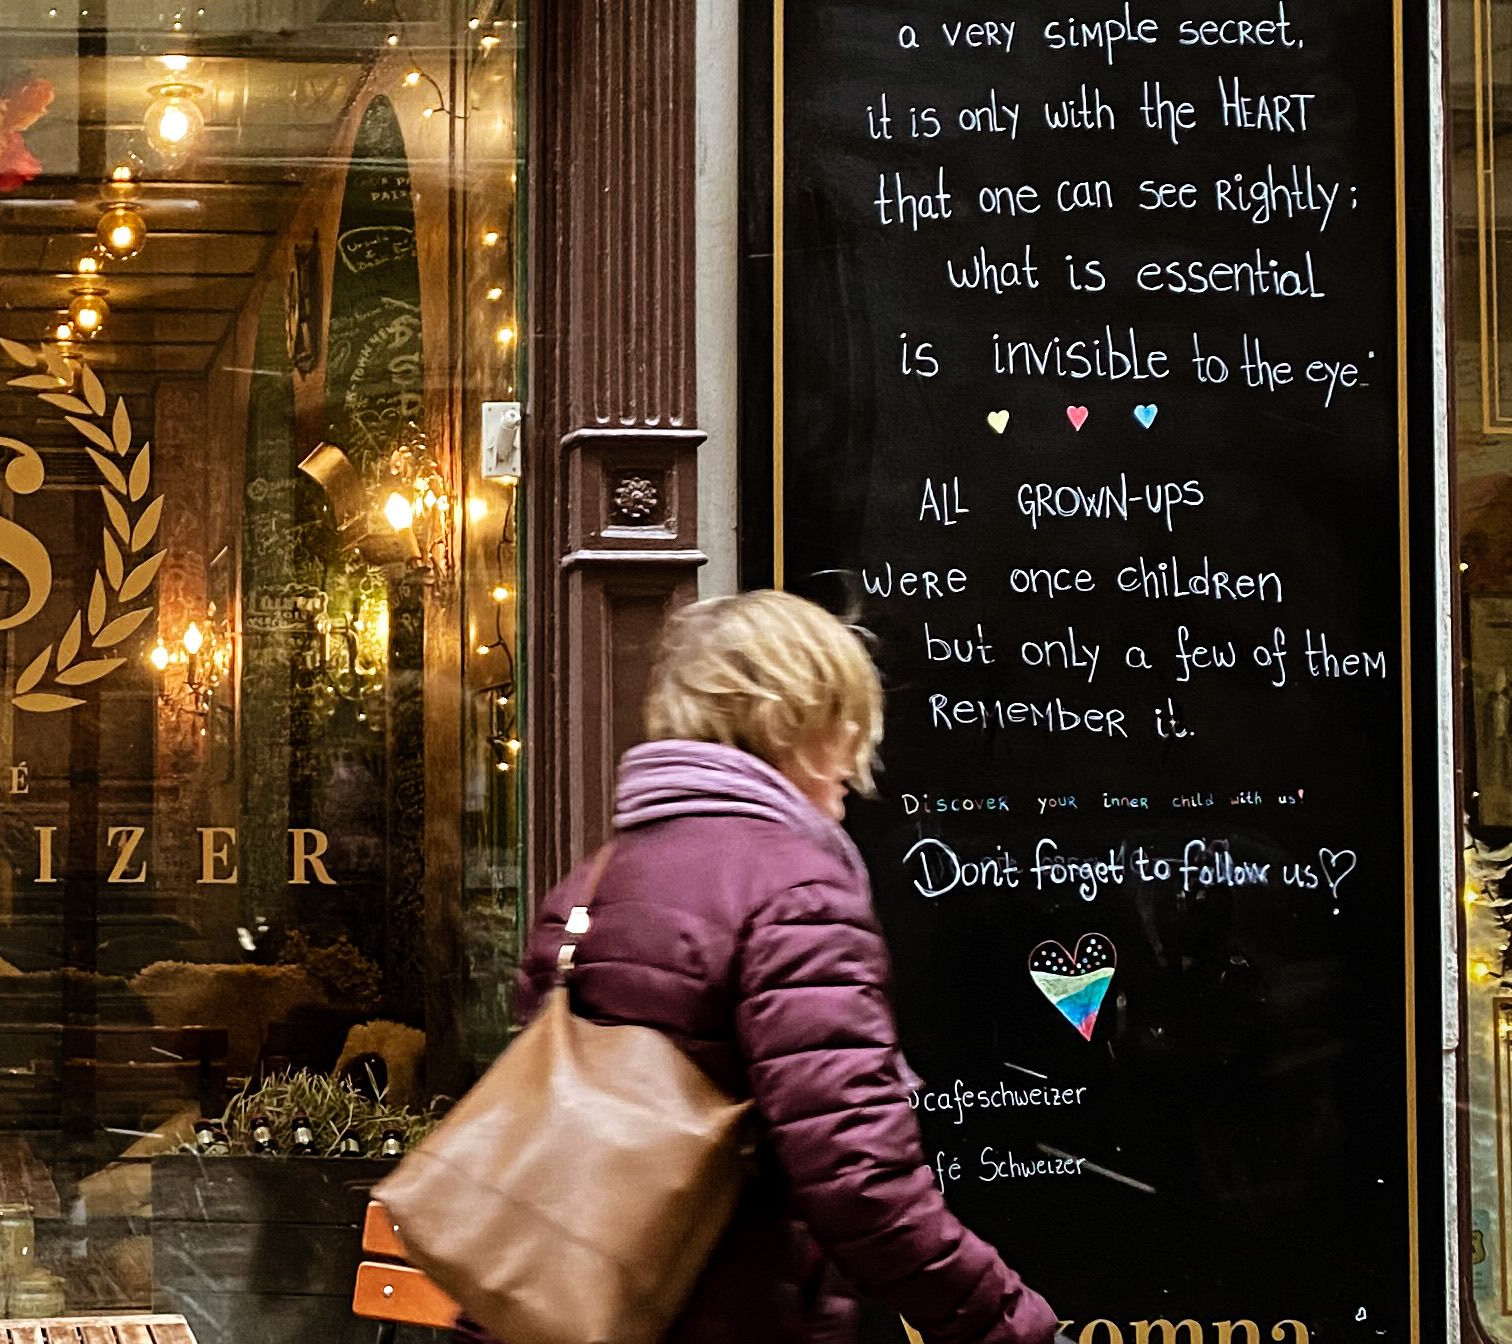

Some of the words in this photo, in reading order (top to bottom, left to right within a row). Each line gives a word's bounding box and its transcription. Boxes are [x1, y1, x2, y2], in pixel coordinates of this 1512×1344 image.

[898, 25, 920, 49] a
[866, 92, 893, 140] it
[909, 107, 941, 138] is
[1044, 85, 1115, 130] with
[1139, 80, 1197, 145] the
[1218, 75, 1316, 133] HEART
[873, 165, 953, 232] that
[979, 184, 1041, 217] one
[1057, 180, 1113, 212] can
[1138, 180, 1198, 210] see
[947, 244, 1040, 295] what
[1065, 254, 1106, 292] is
[899, 332, 939, 378] is
[992, 324, 1170, 381] invisible
[1191, 332, 1229, 384] to
[1240, 333, 1294, 392] the
[919, 476, 970, 526] ALL
[1009, 568, 1096, 599] once
[924, 622, 993, 664] but
[1125, 646, 1153, 669] a
[1175, 625, 1236, 682] few
[1253, 626, 1287, 688] of
[1154, 697, 1195, 738] it.
[1172, 792, 1214, 808] child
[1230, 791, 1262, 805] with
[1029, 837, 1125, 902] forget
[1135, 846, 1171, 882] to
[979, 1147, 1086, 1181] Schweizer
